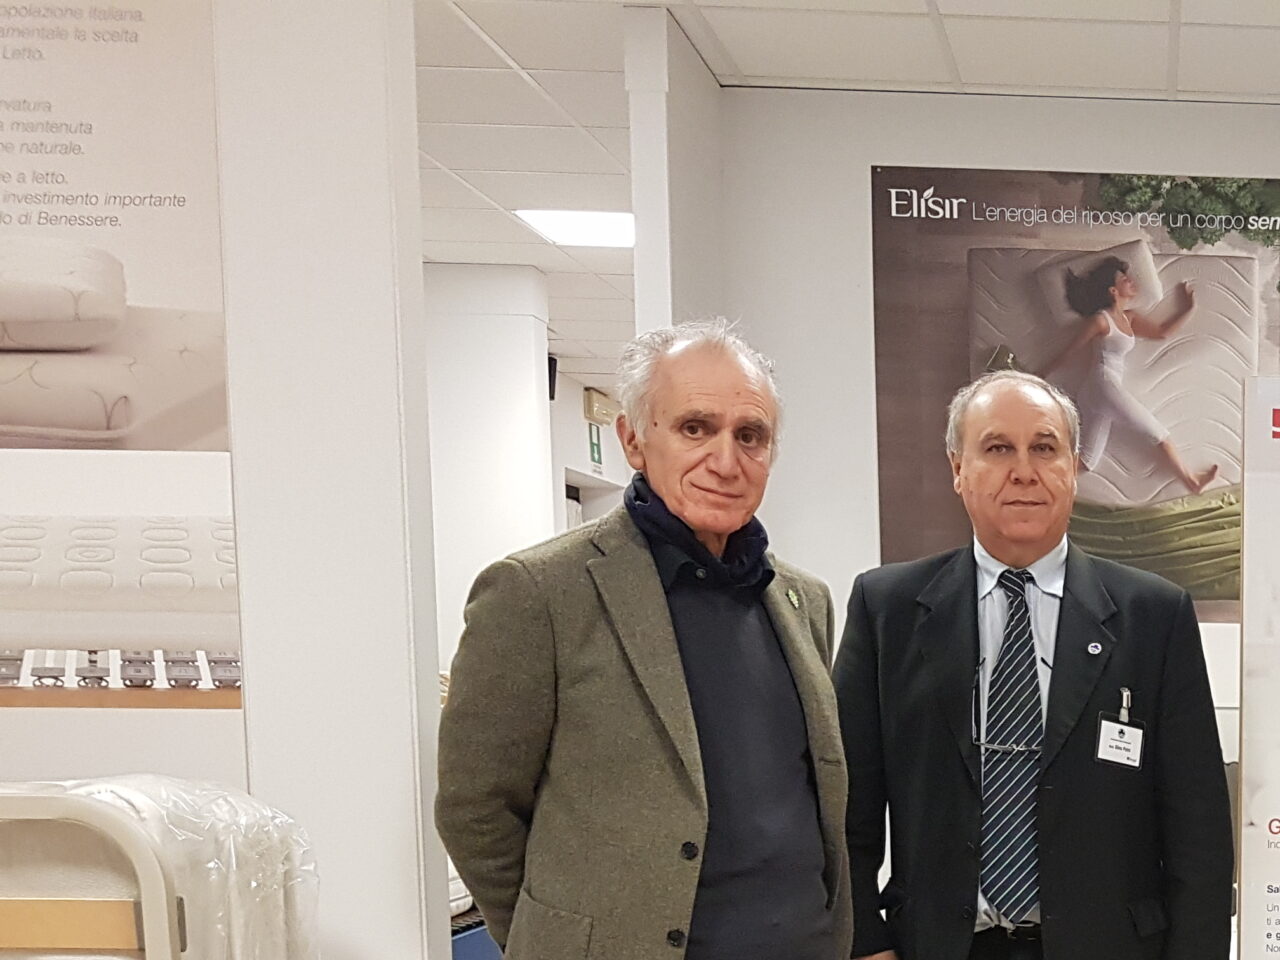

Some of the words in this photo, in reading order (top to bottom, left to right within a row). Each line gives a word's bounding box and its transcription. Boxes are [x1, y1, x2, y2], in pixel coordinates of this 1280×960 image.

[10, 120, 93, 135] mantenuta
[19, 141, 85, 155] naturale.
[31, 170, 68, 185] letto.
[3, 192, 99, 207] investimento
[104, 192, 186, 208] importante
[887, 186, 967, 219] Elisir
[18, 212, 32, 225] di
[37, 211, 122, 227] Benessere.
[972, 202, 1048, 227] L'energia
[1052, 205, 1077, 224] del
[1082, 206, 1134, 229] riposo
[1137, 212, 1166, 231] per
[1169, 213, 1191, 228] un
[1195, 214, 1245, 231] corpo
[1266, 903, 1280, 912] Un
[1266, 932, 1273, 940] e
